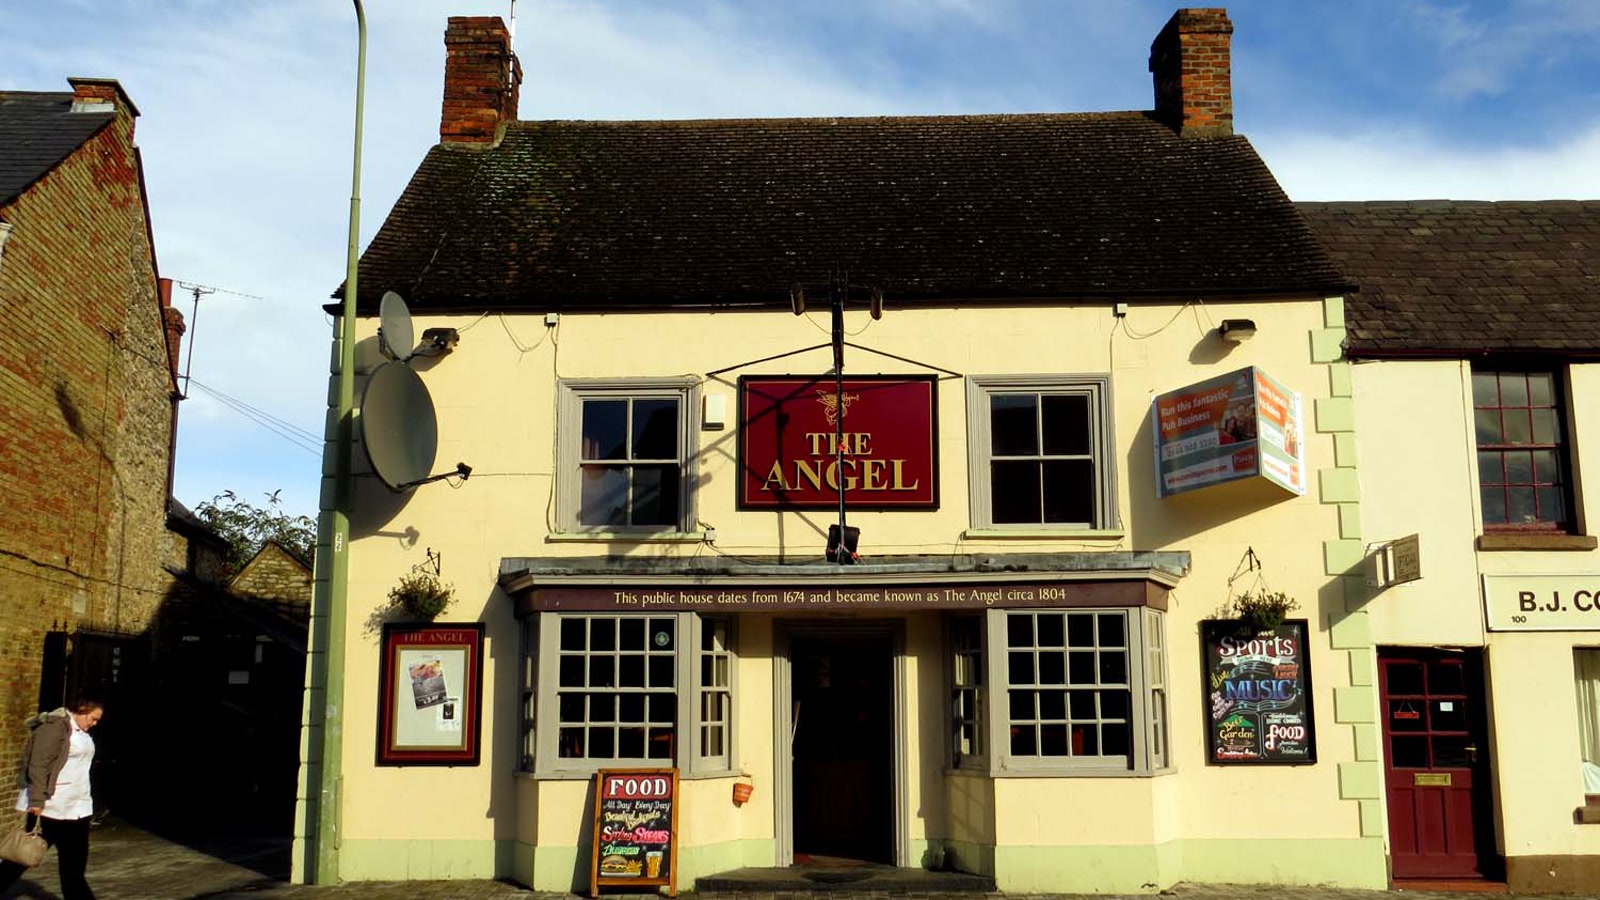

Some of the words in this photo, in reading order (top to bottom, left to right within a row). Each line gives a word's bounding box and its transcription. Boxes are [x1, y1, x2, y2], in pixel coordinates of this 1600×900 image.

[1161, 406, 1175, 417] Run
[1177, 400, 1191, 412] this
[1193, 389, 1229, 406] fantastic
[1162, 421, 1176, 431] Pub
[1177, 411, 1210, 427] Business
[806, 433, 872, 455] THE
[761, 459, 919, 490] ANGEL
[615, 592, 637, 604] This
[643, 592, 675, 607] public
[680, 592, 713, 603] house
[718, 592, 747, 603] dates
[752, 591, 777, 603] from
[784, 592, 804, 602] 1674
[810, 592, 830, 602] and
[836, 591, 879, 601] became
[884, 591, 921, 601] known
[926, 593, 939, 601] as
[943, 590, 965, 601] The
[969, 589, 1001, 604] Angel
[1007, 590, 1034, 600] circa
[1039, 589, 1066, 599] 1804
[1519, 591, 1566, 611] B.J.
[404, 633, 425, 642] THE
[429, 632, 466, 641] ANGEL
[1220, 636, 1293, 655] Sports
[1224, 680, 1291, 700] MUSIC
[1224, 716, 1243, 731] Beer
[1220, 728, 1255, 740] Garden
[610, 779, 666, 795] FOOD
[604, 801, 615, 809] All
[617, 801, 632, 811] Day
[654, 801, 670, 812] Day
